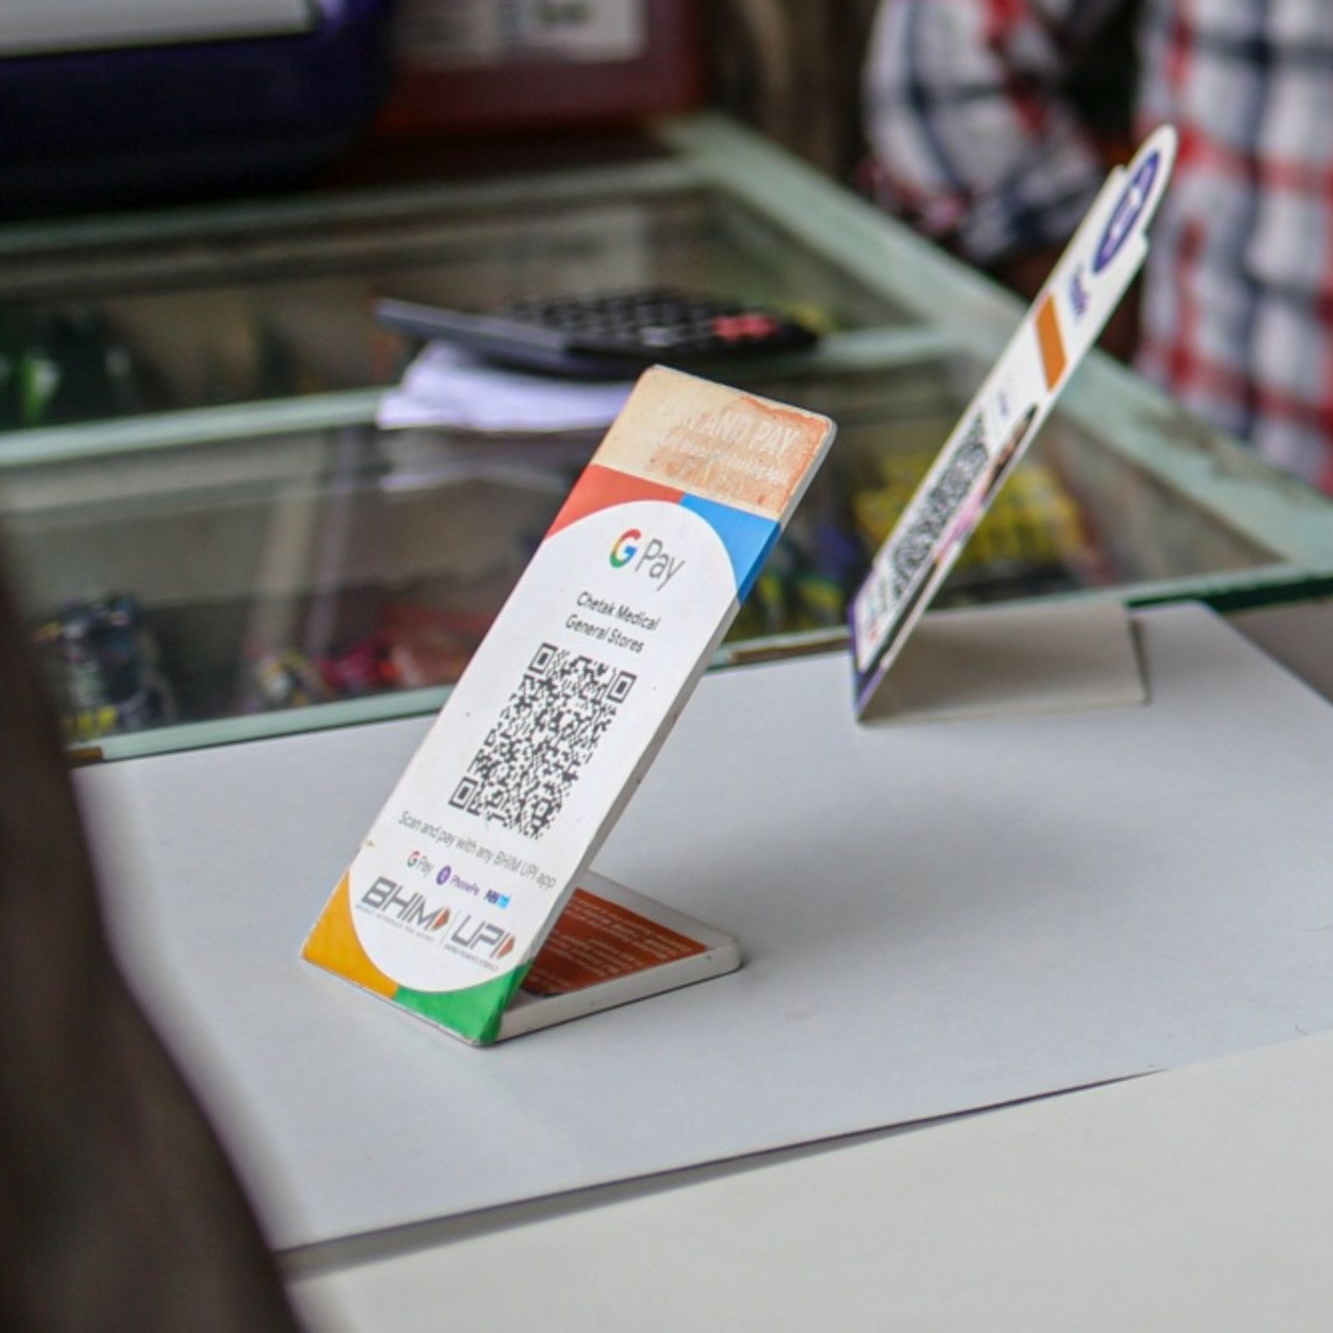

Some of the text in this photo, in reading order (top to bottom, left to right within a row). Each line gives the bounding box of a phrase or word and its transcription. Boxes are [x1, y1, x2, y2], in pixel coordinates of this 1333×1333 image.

[609, 528, 686, 592] G Pay
[565, 614, 645, 654] General Stores
[577, 591, 662, 631] Chetak Medical
[398, 811, 557, 891] Scan and pay with any BHIM UPI app
[361, 876, 444, 932] BHIM
[451, 914, 511, 959] UPI
